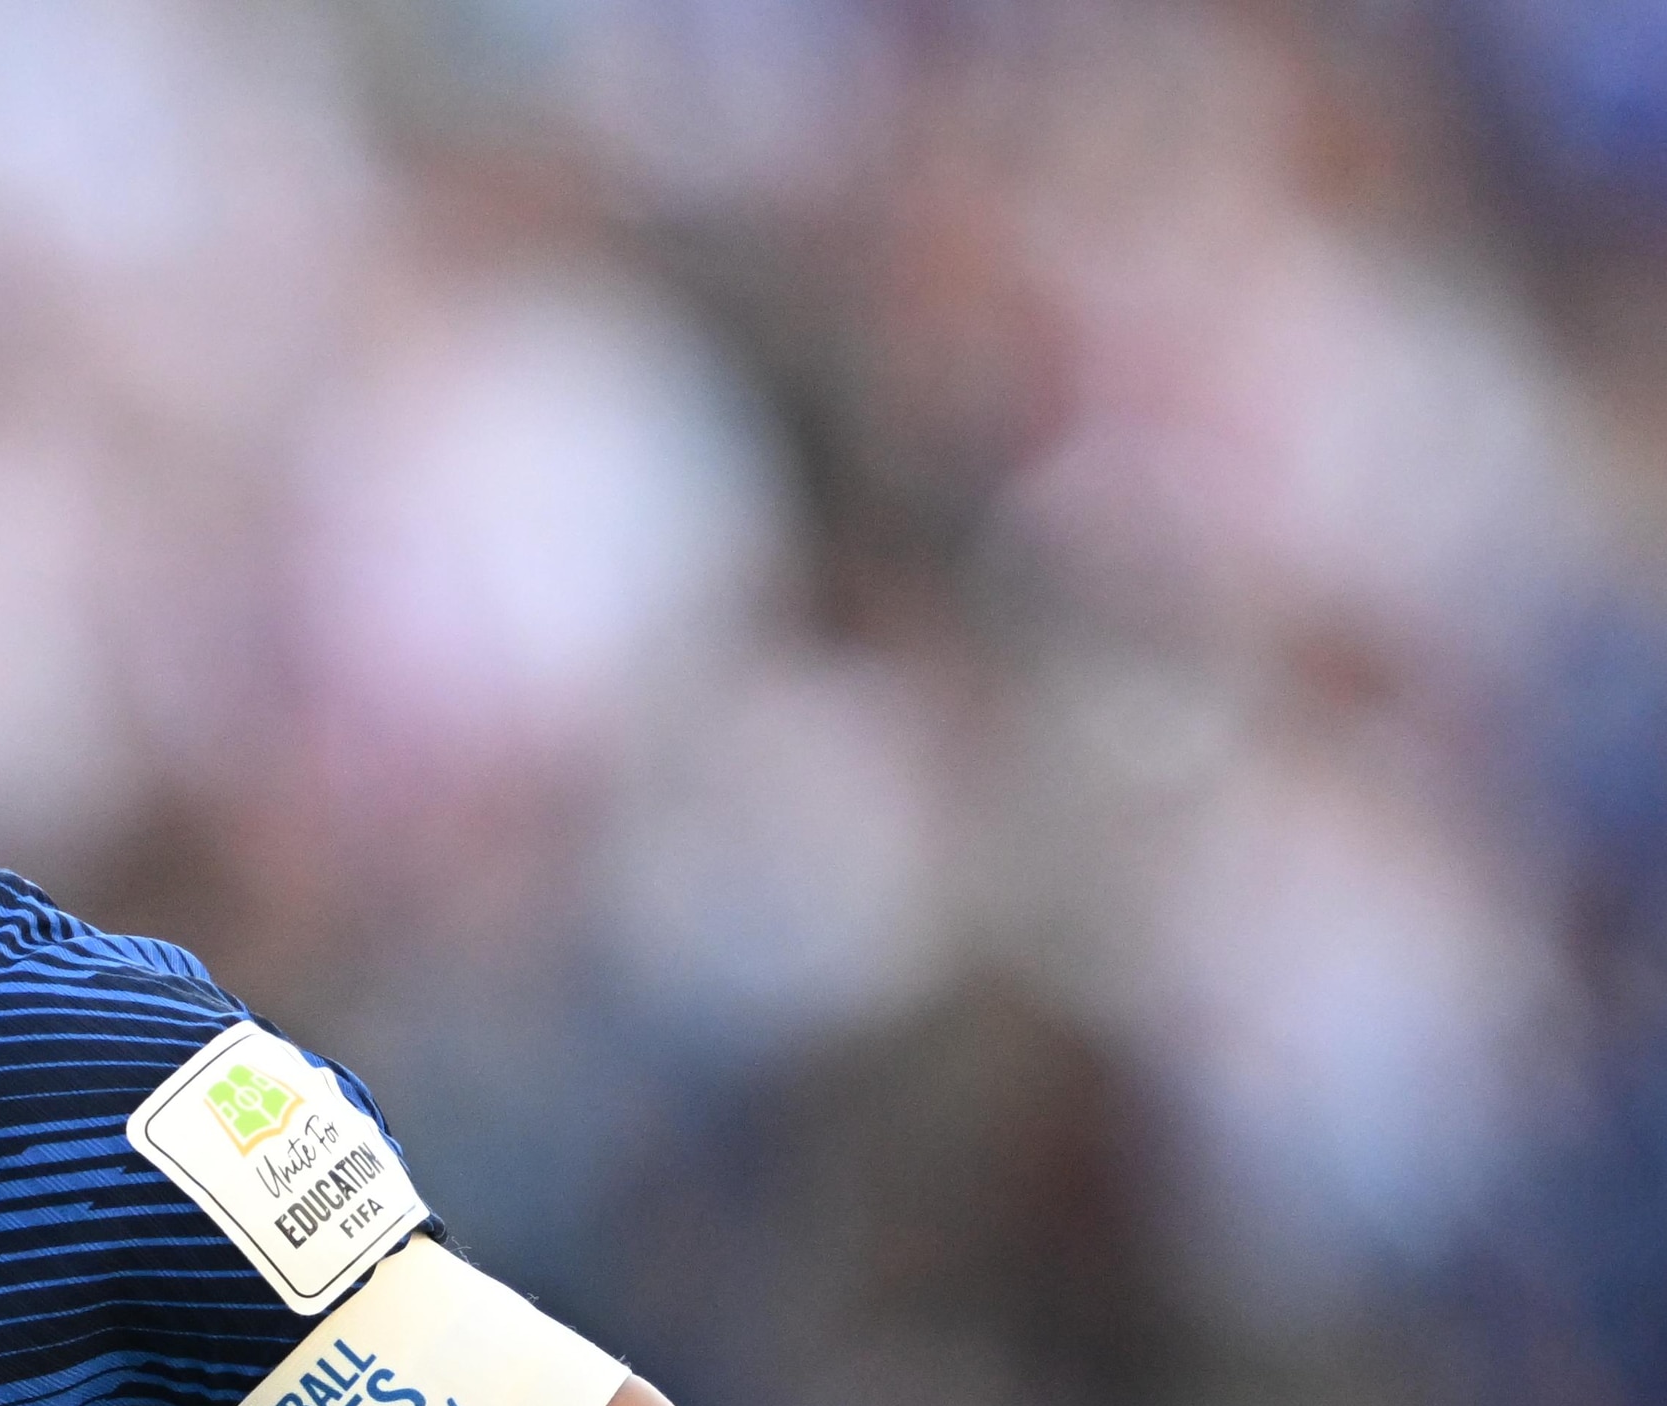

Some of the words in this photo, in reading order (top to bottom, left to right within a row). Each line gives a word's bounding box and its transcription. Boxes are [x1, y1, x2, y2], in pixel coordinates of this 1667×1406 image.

[256, 1138, 317, 1199] Unite
[305, 1114, 340, 1154] For
[274, 1142, 385, 1250] EDUCATION
[339, 1198, 384, 1239] FIFA
